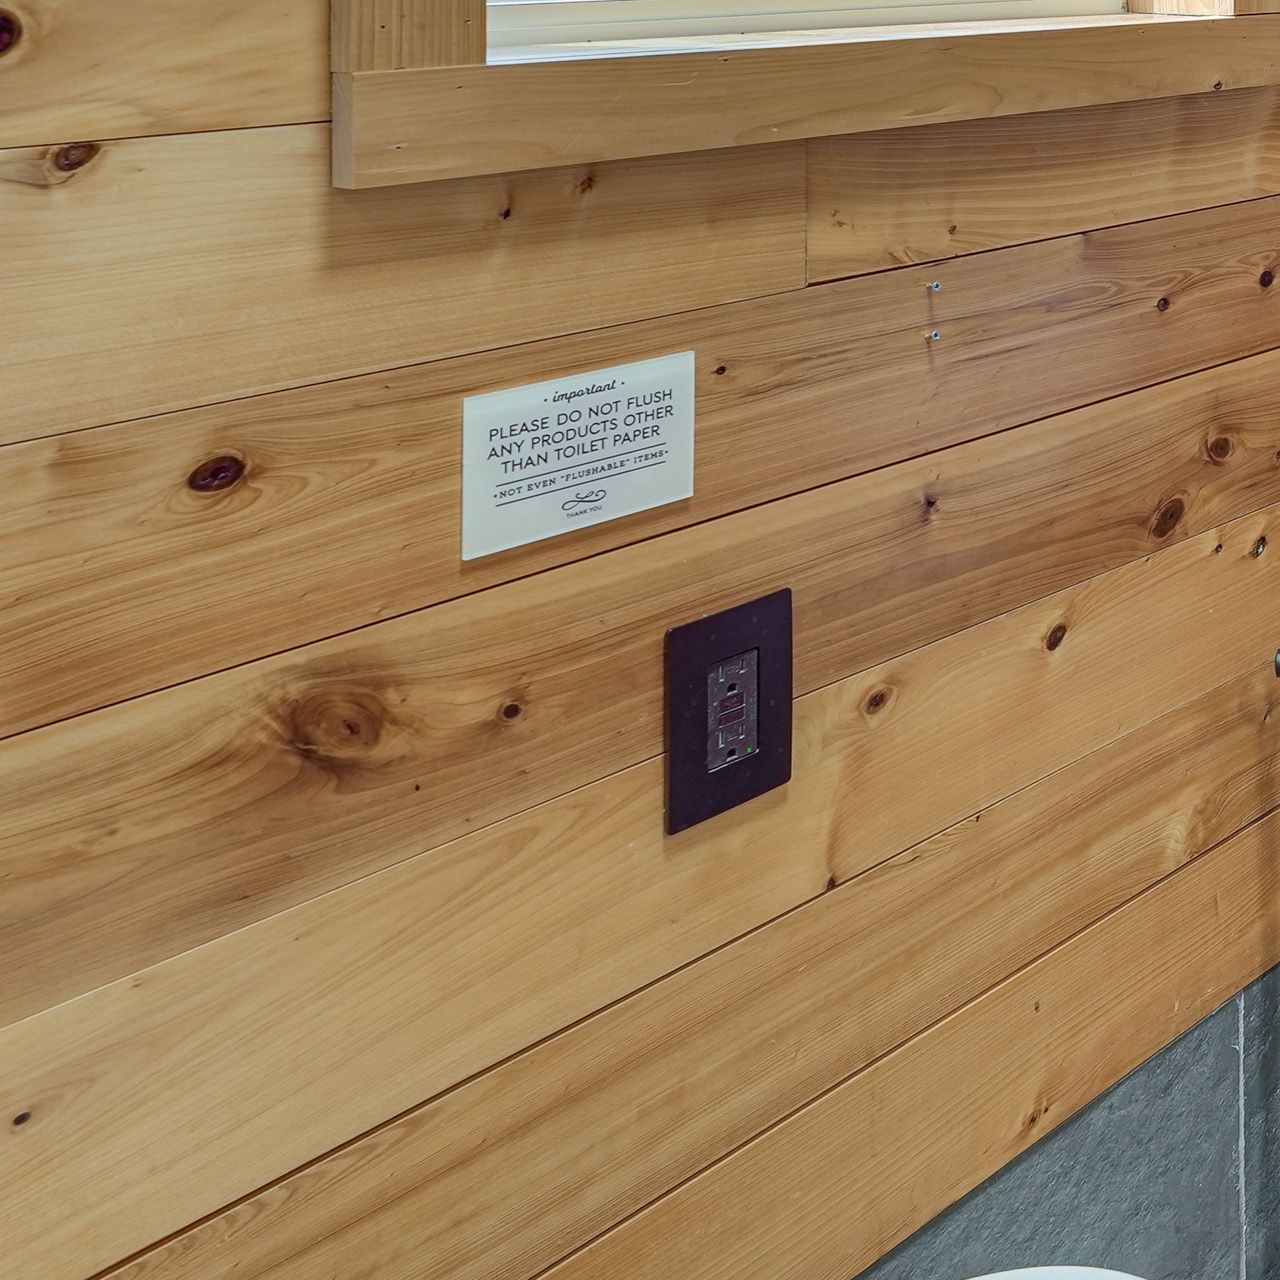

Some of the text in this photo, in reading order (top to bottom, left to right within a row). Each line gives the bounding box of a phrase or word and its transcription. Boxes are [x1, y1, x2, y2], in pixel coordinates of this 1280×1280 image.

[489, 388, 673, 442] PLEASE DO NOT FLUSH
[552, 379, 616, 403] important
[487, 405, 674, 461] ANY PRODUCTS OTHER
[501, 424, 661, 474] THAN TOILET PAPER
[498, 450, 664, 500] NOT EVEN "FLUSHABLE" ITEMS
[566, 504, 604, 519] THANK YOU
